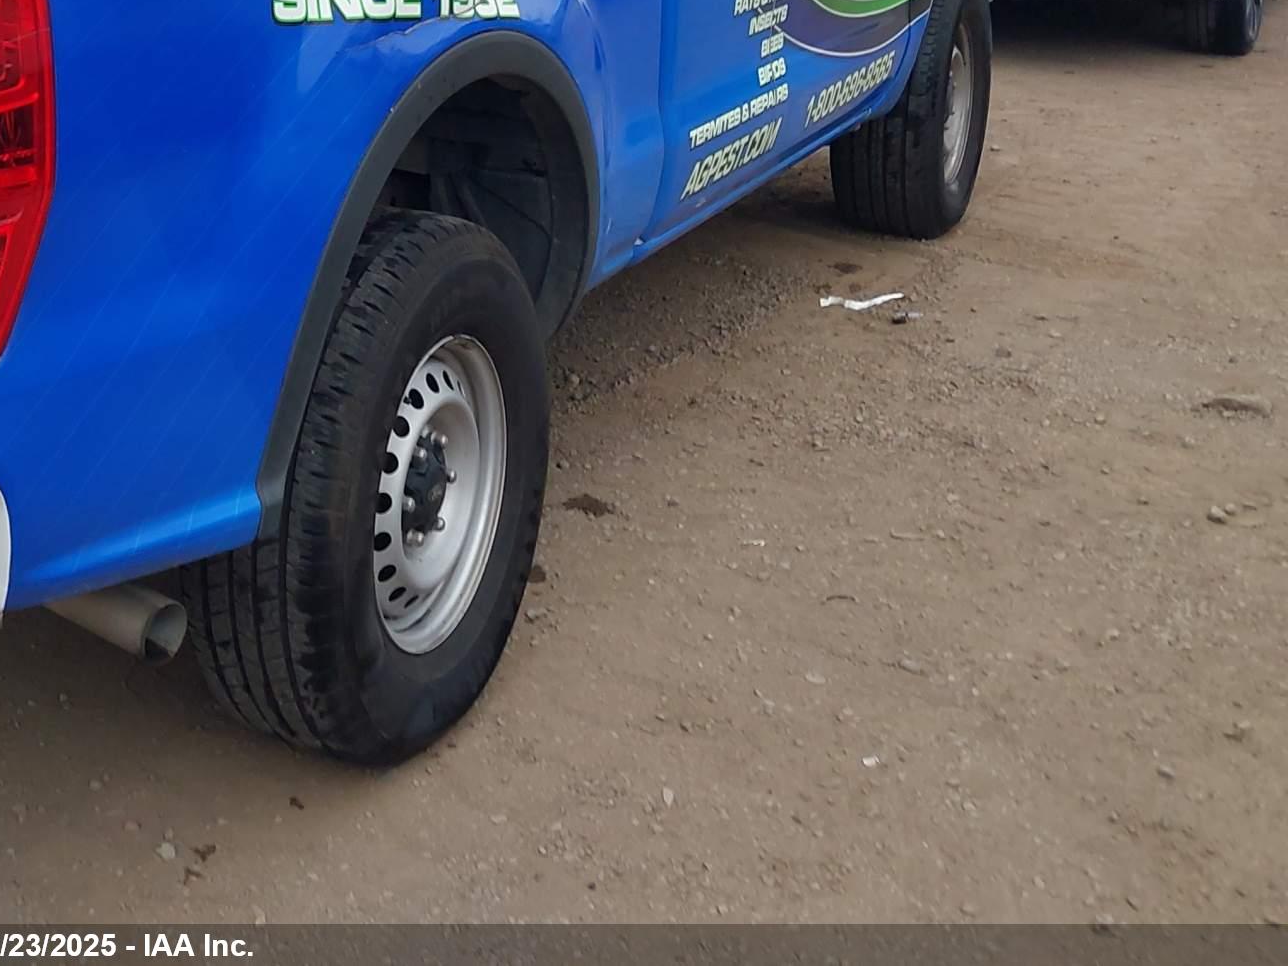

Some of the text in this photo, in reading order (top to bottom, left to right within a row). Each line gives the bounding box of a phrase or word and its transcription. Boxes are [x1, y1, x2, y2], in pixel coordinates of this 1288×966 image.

[748, 3, 789, 36] INSECTS
[690, 83, 788, 148] TERMITES & REPAIRS
[679, 116, 783, 202] AGPEST.COM
